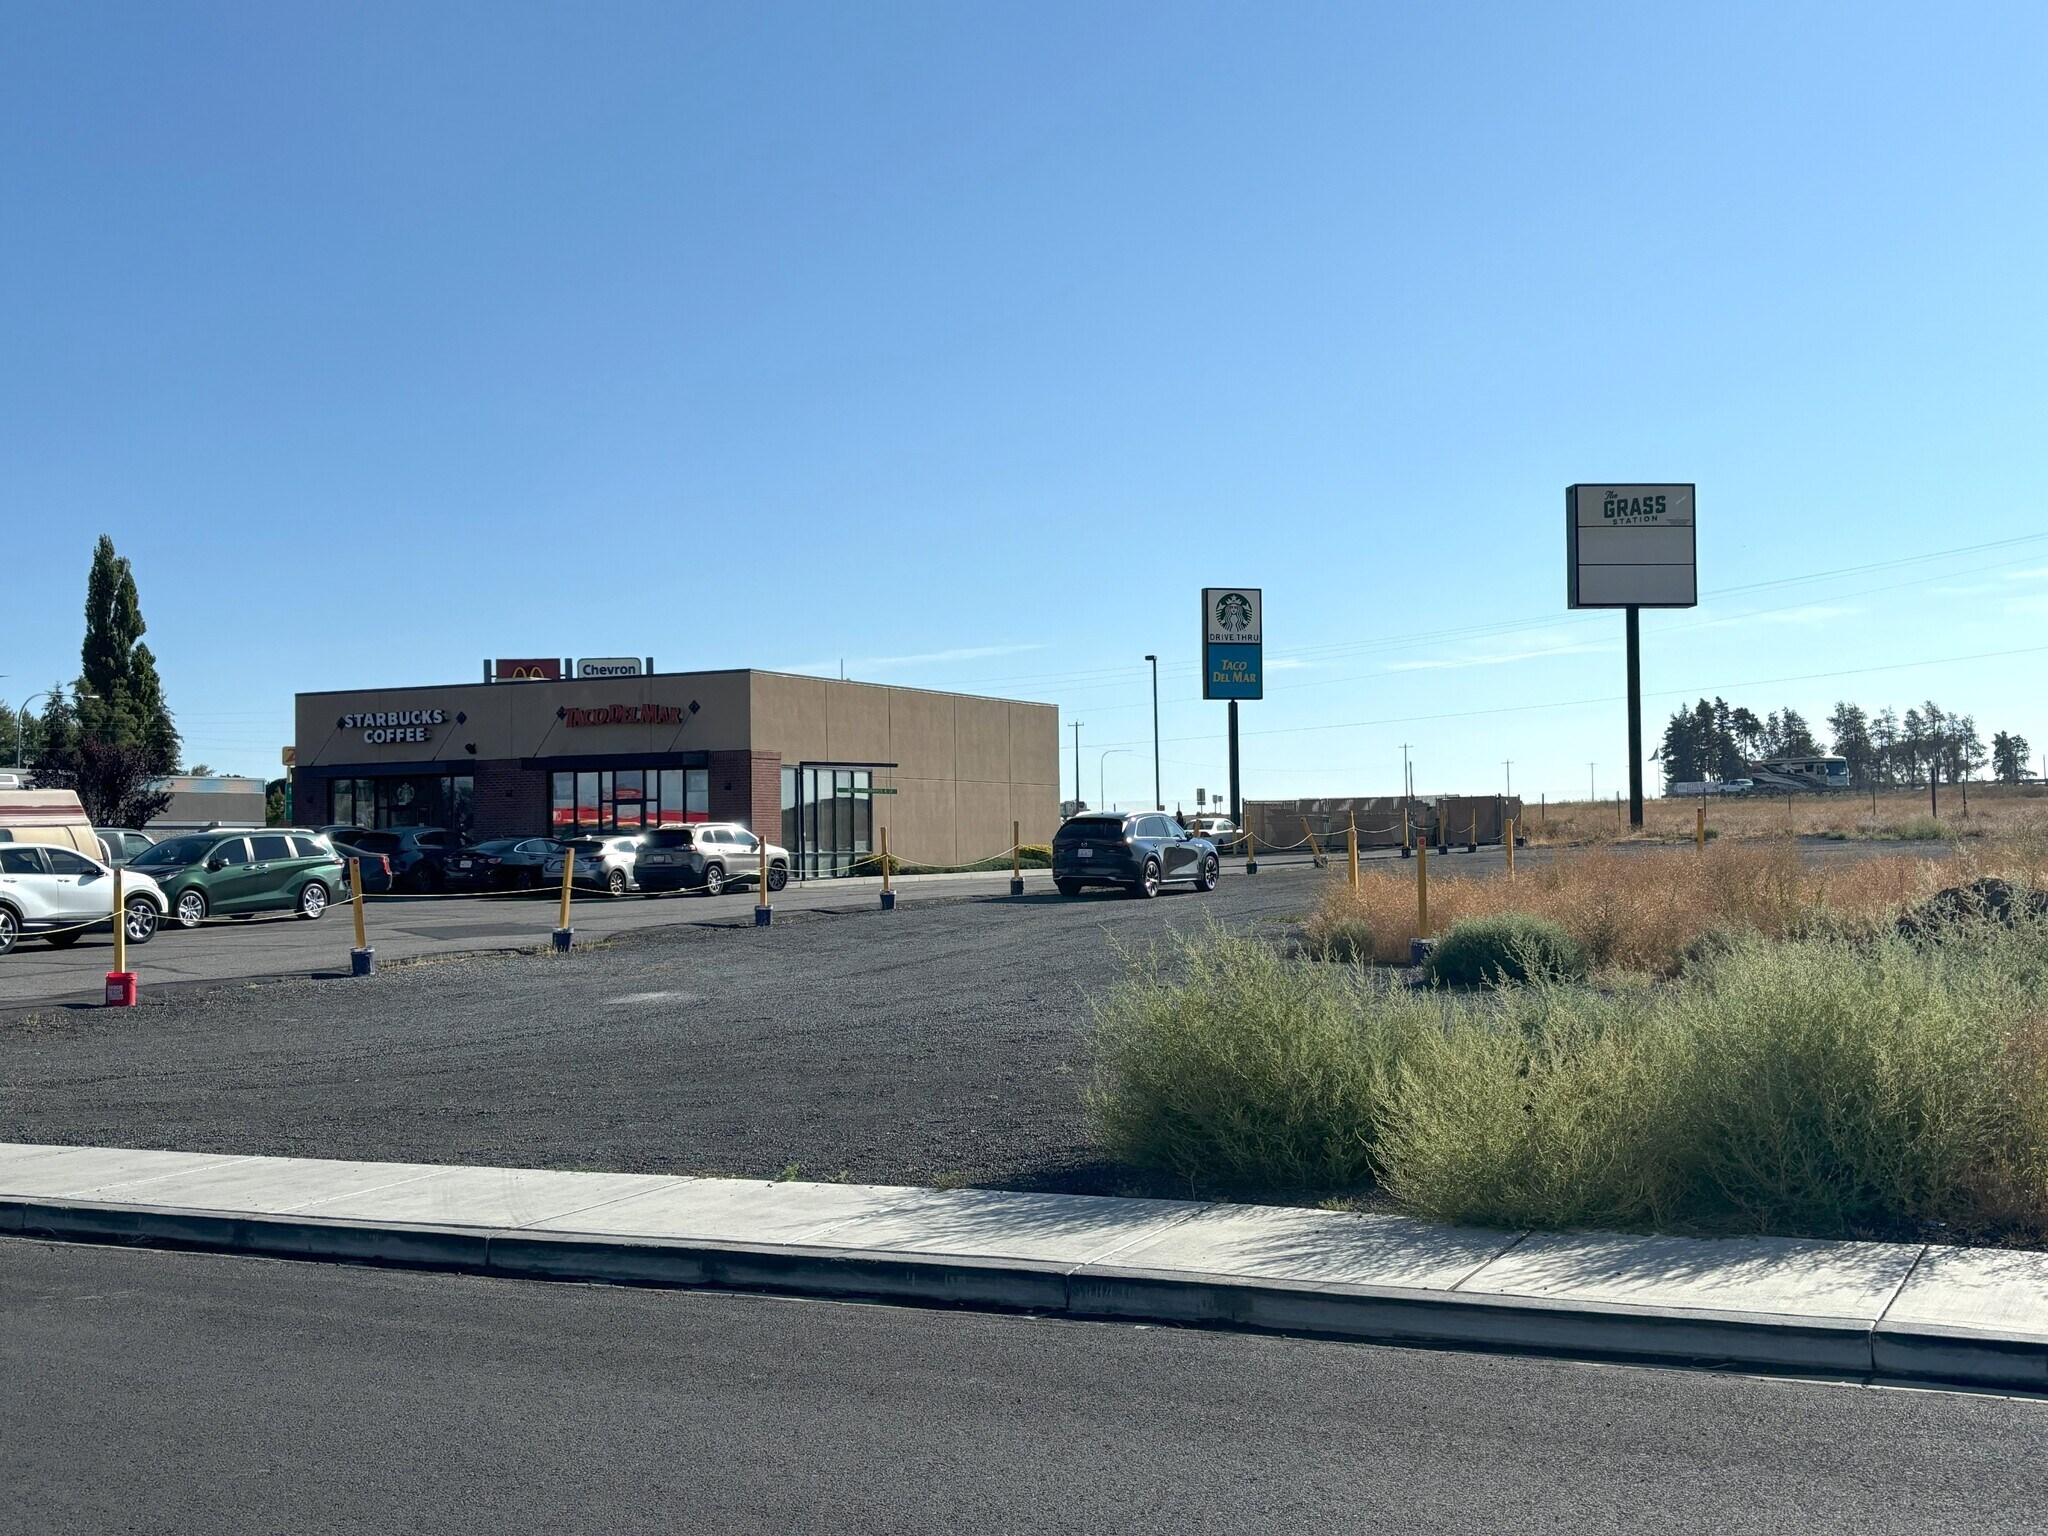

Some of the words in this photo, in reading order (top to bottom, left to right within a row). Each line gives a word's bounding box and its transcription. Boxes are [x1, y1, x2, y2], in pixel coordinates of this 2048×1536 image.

[1604, 496, 1666, 518] GRASS
[1612, 515, 1658, 525] STATION
[1210, 633, 1234, 641] DRIVE
[582, 664, 636, 676] Chevron
[344, 709, 445, 729] STARBUCKS
[363, 727, 426, 744] COFFEE
